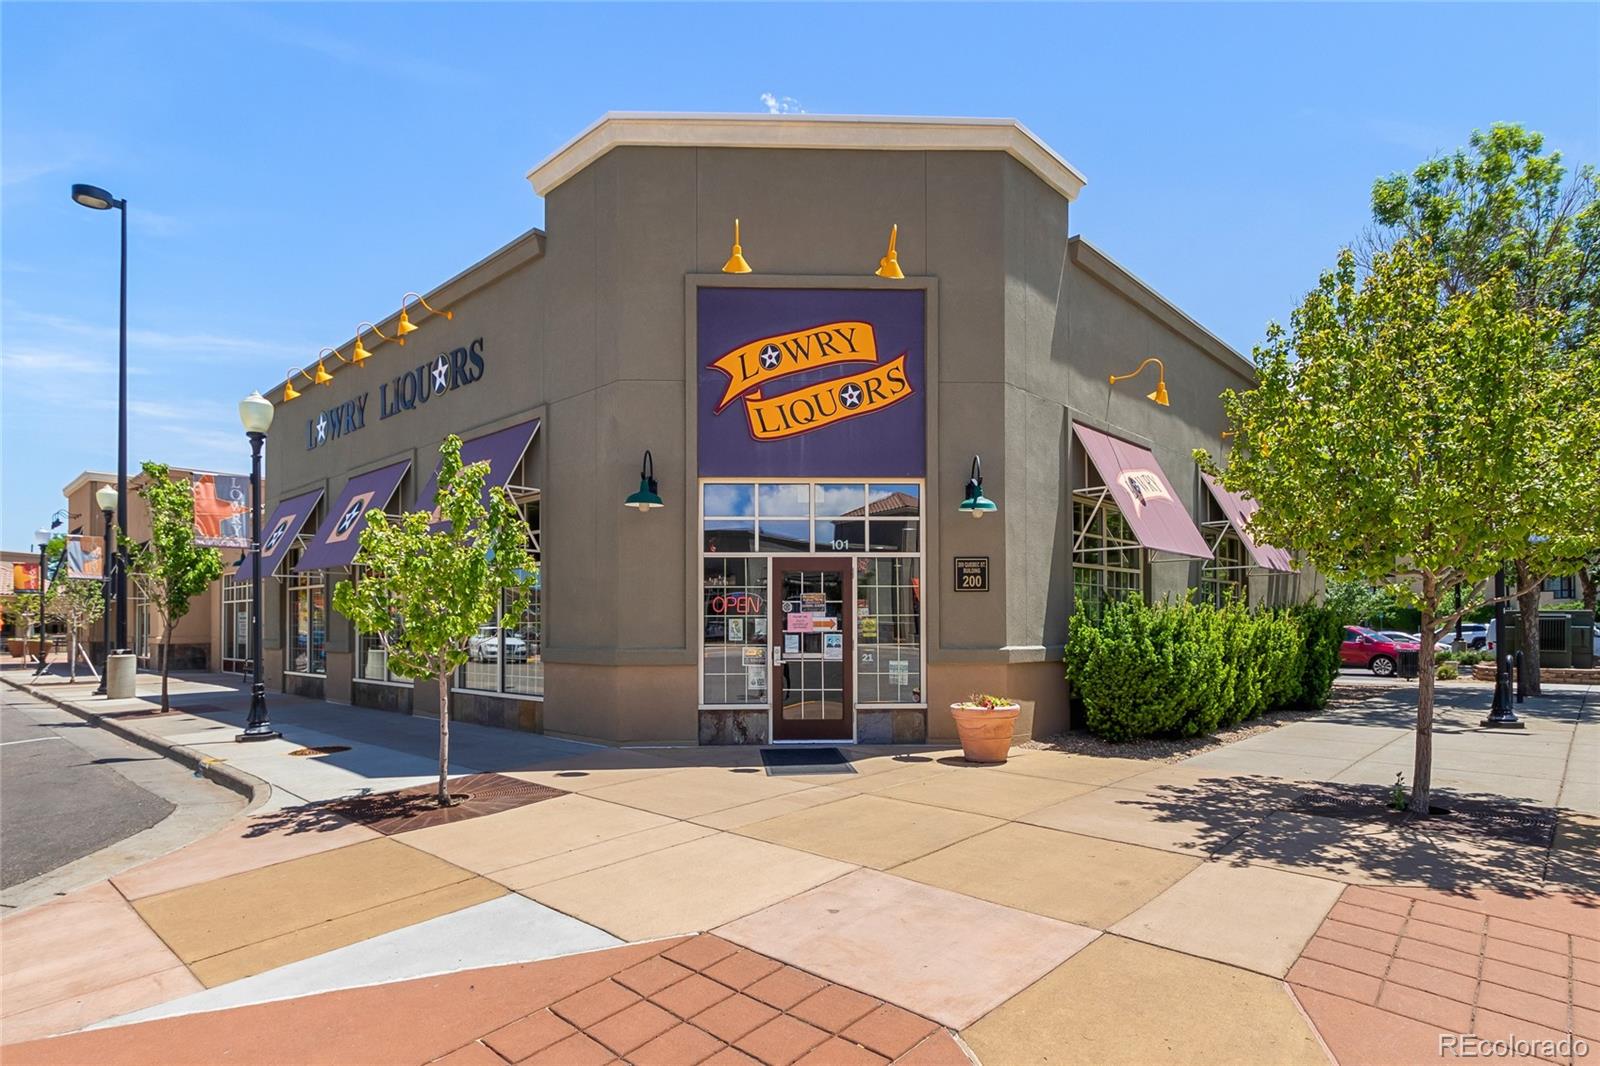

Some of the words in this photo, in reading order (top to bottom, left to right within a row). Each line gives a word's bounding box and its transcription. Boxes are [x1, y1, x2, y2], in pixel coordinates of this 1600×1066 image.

[738, 328, 859, 381] LOWRY
[306, 392, 368, 450] LOWRY
[379, 337, 484, 420] LIQUORS
[754, 366, 907, 433] LIQUORS
[830, 539, 849, 550] 101
[962, 575, 982, 588] 200
[712, 596, 760, 613] OPEN
